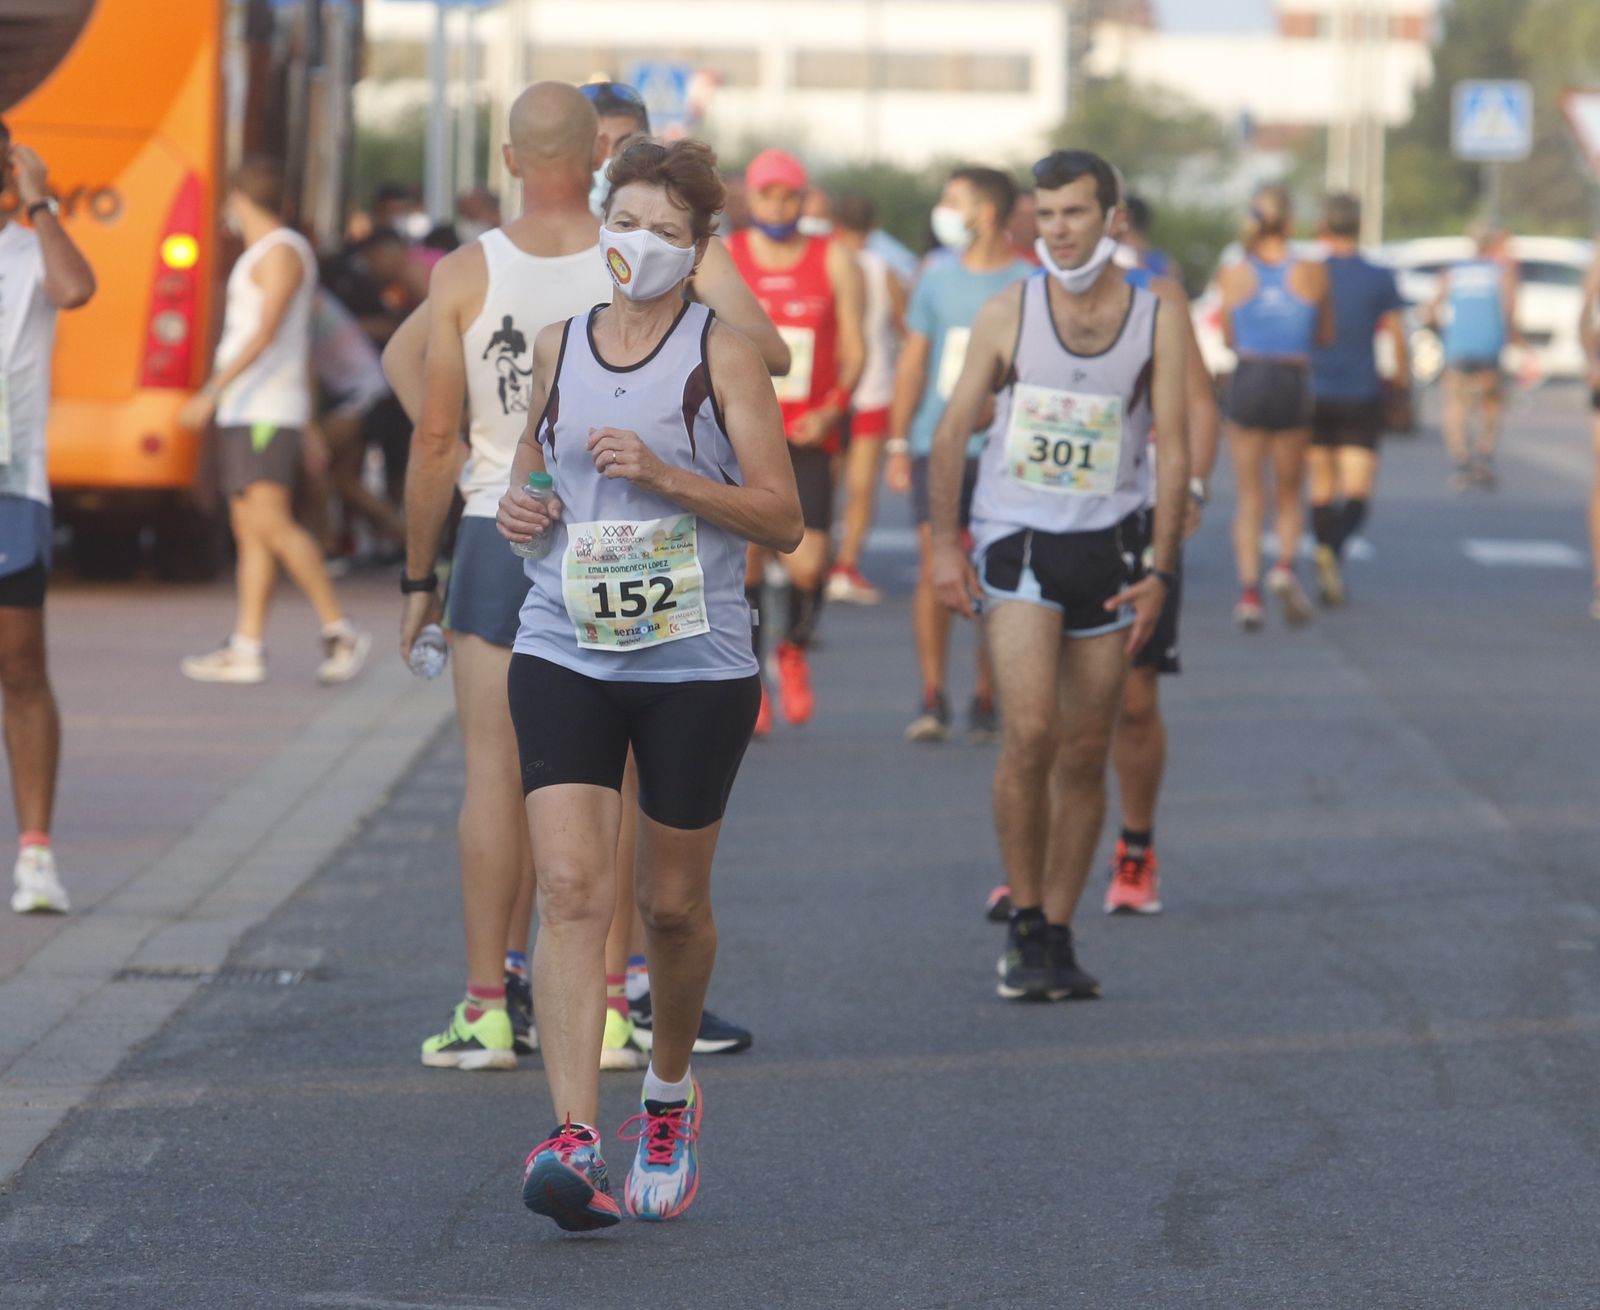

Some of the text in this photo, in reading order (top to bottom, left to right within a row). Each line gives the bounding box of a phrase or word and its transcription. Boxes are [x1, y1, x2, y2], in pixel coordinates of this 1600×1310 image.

[1028, 435, 1094, 469] 301
[602, 525, 638, 538] XXXV
[588, 559, 669, 574] EMILIA DOMENECH LOPEZ
[592, 577, 677, 618] 152
[614, 622, 660, 636] serizona
